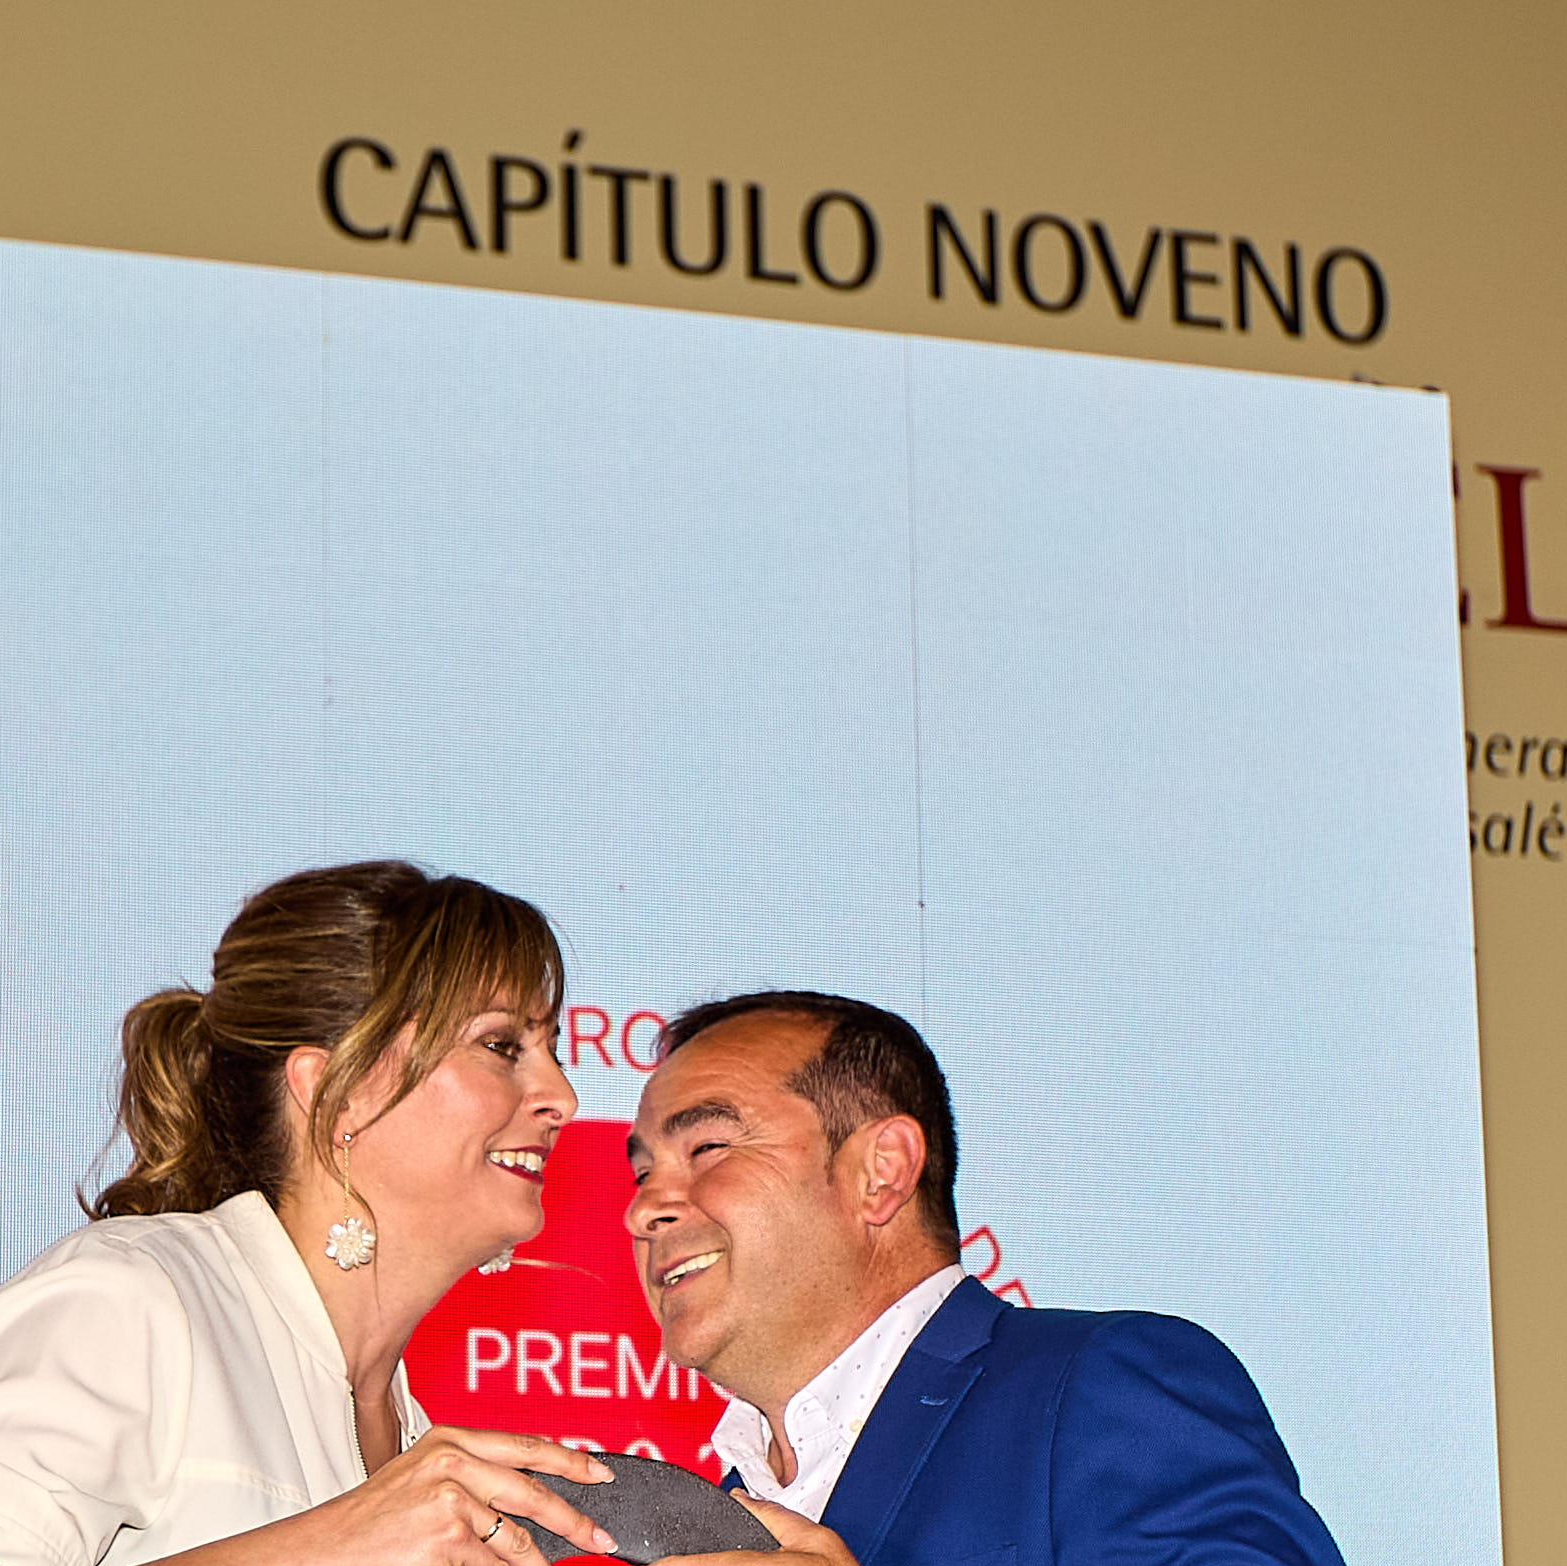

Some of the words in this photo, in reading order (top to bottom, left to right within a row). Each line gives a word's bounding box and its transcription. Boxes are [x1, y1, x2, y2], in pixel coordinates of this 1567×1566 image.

[317, 127, 882, 292] CAPÍTULO
[926, 200, 1391, 347] NOVENO
[465, 1326, 734, 1401] PREMI
